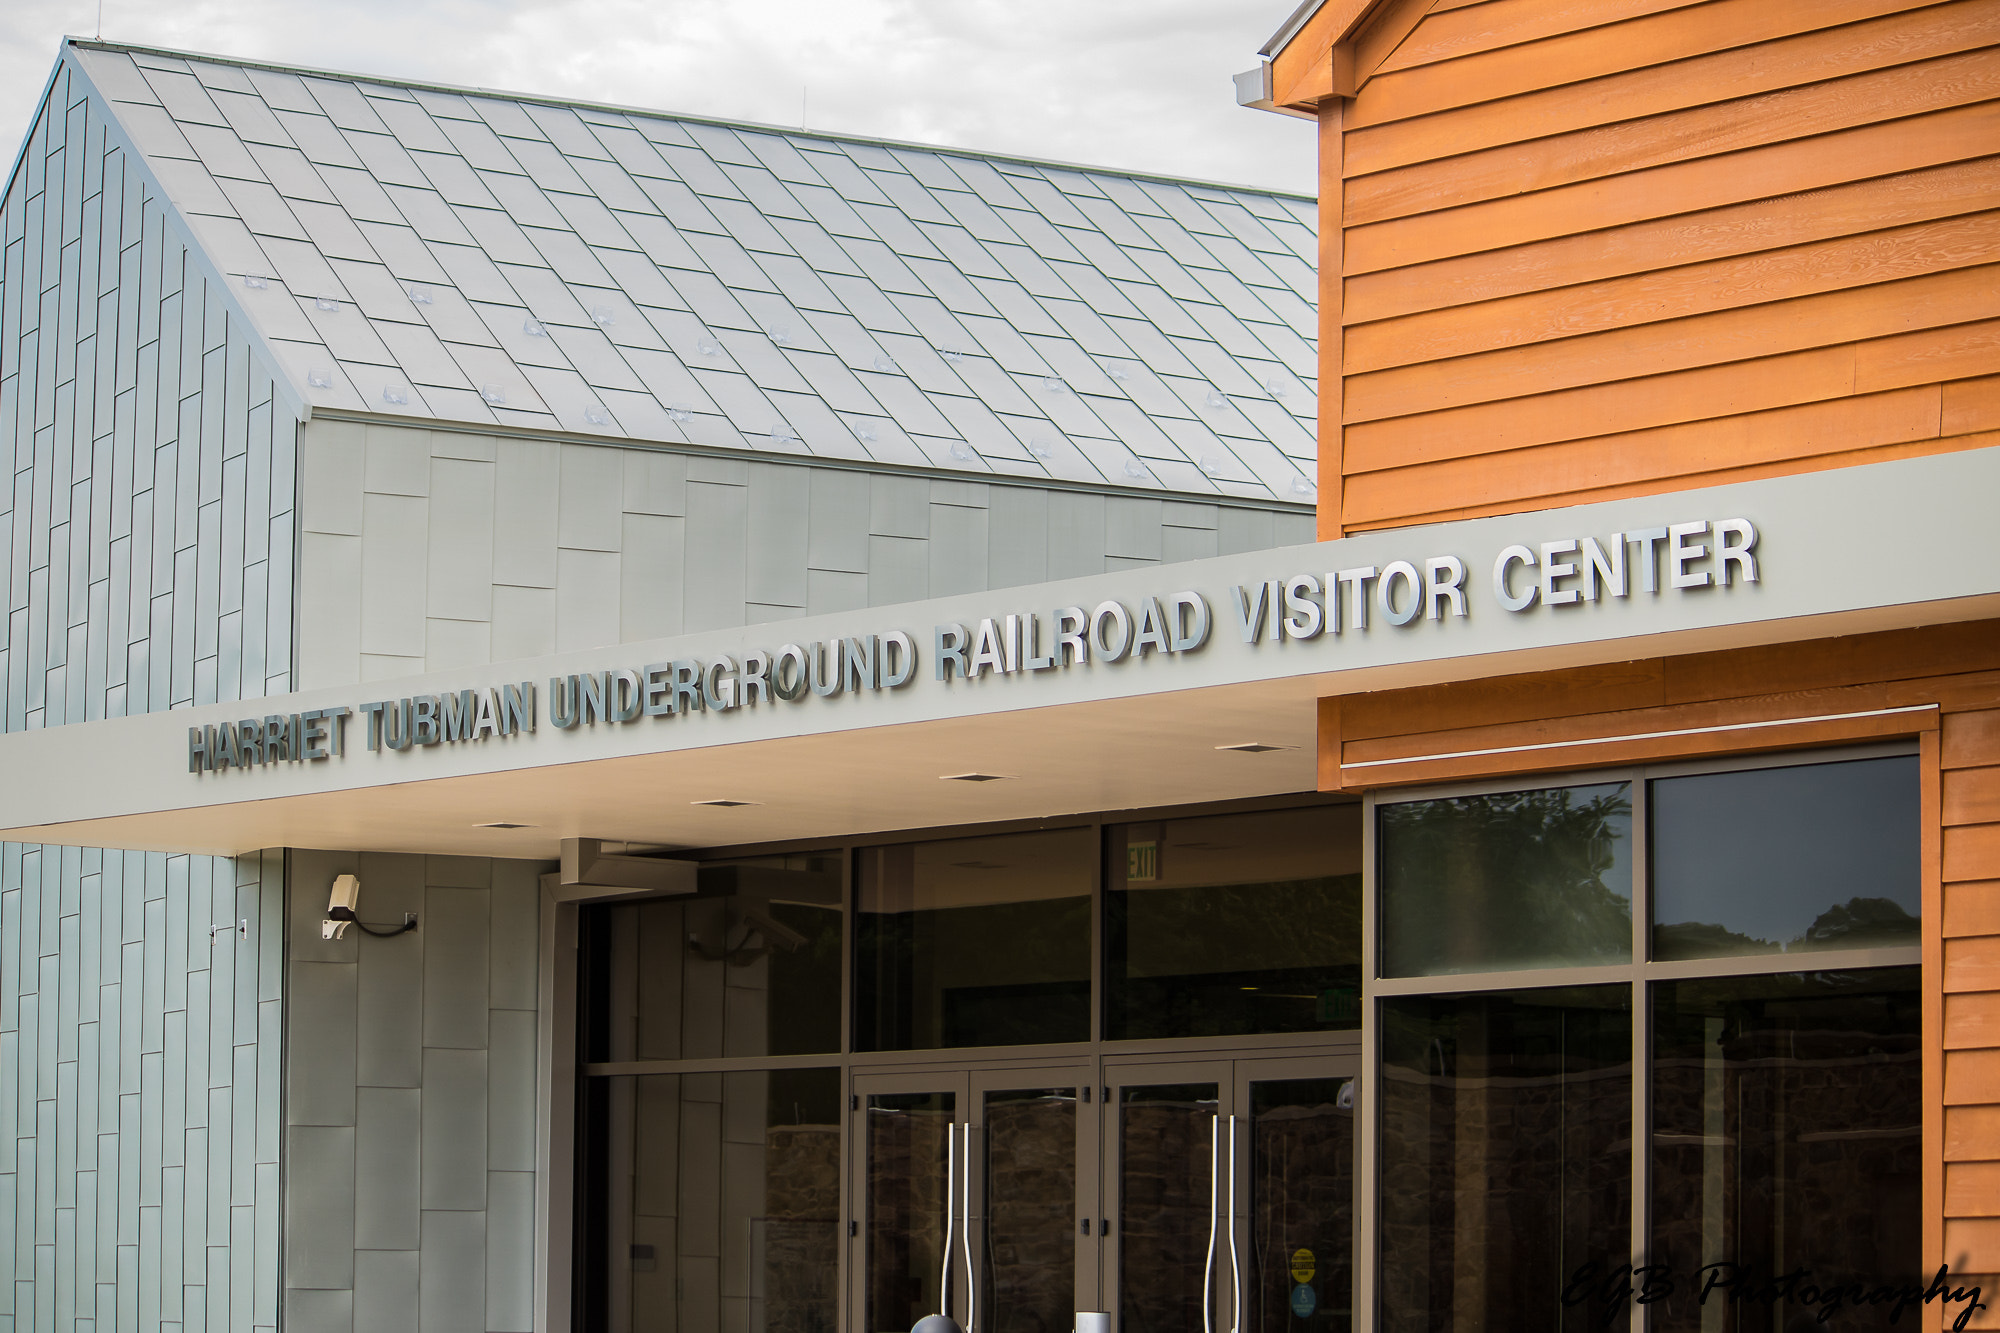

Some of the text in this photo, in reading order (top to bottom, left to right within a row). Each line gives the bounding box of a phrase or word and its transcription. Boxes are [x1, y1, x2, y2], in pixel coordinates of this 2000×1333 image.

[188, 517, 1760, 773] HARRIET TUBMAN UNDERGROUND RAILROAD VISITOR CENTER
[1127, 846, 1156, 878] EXIT
